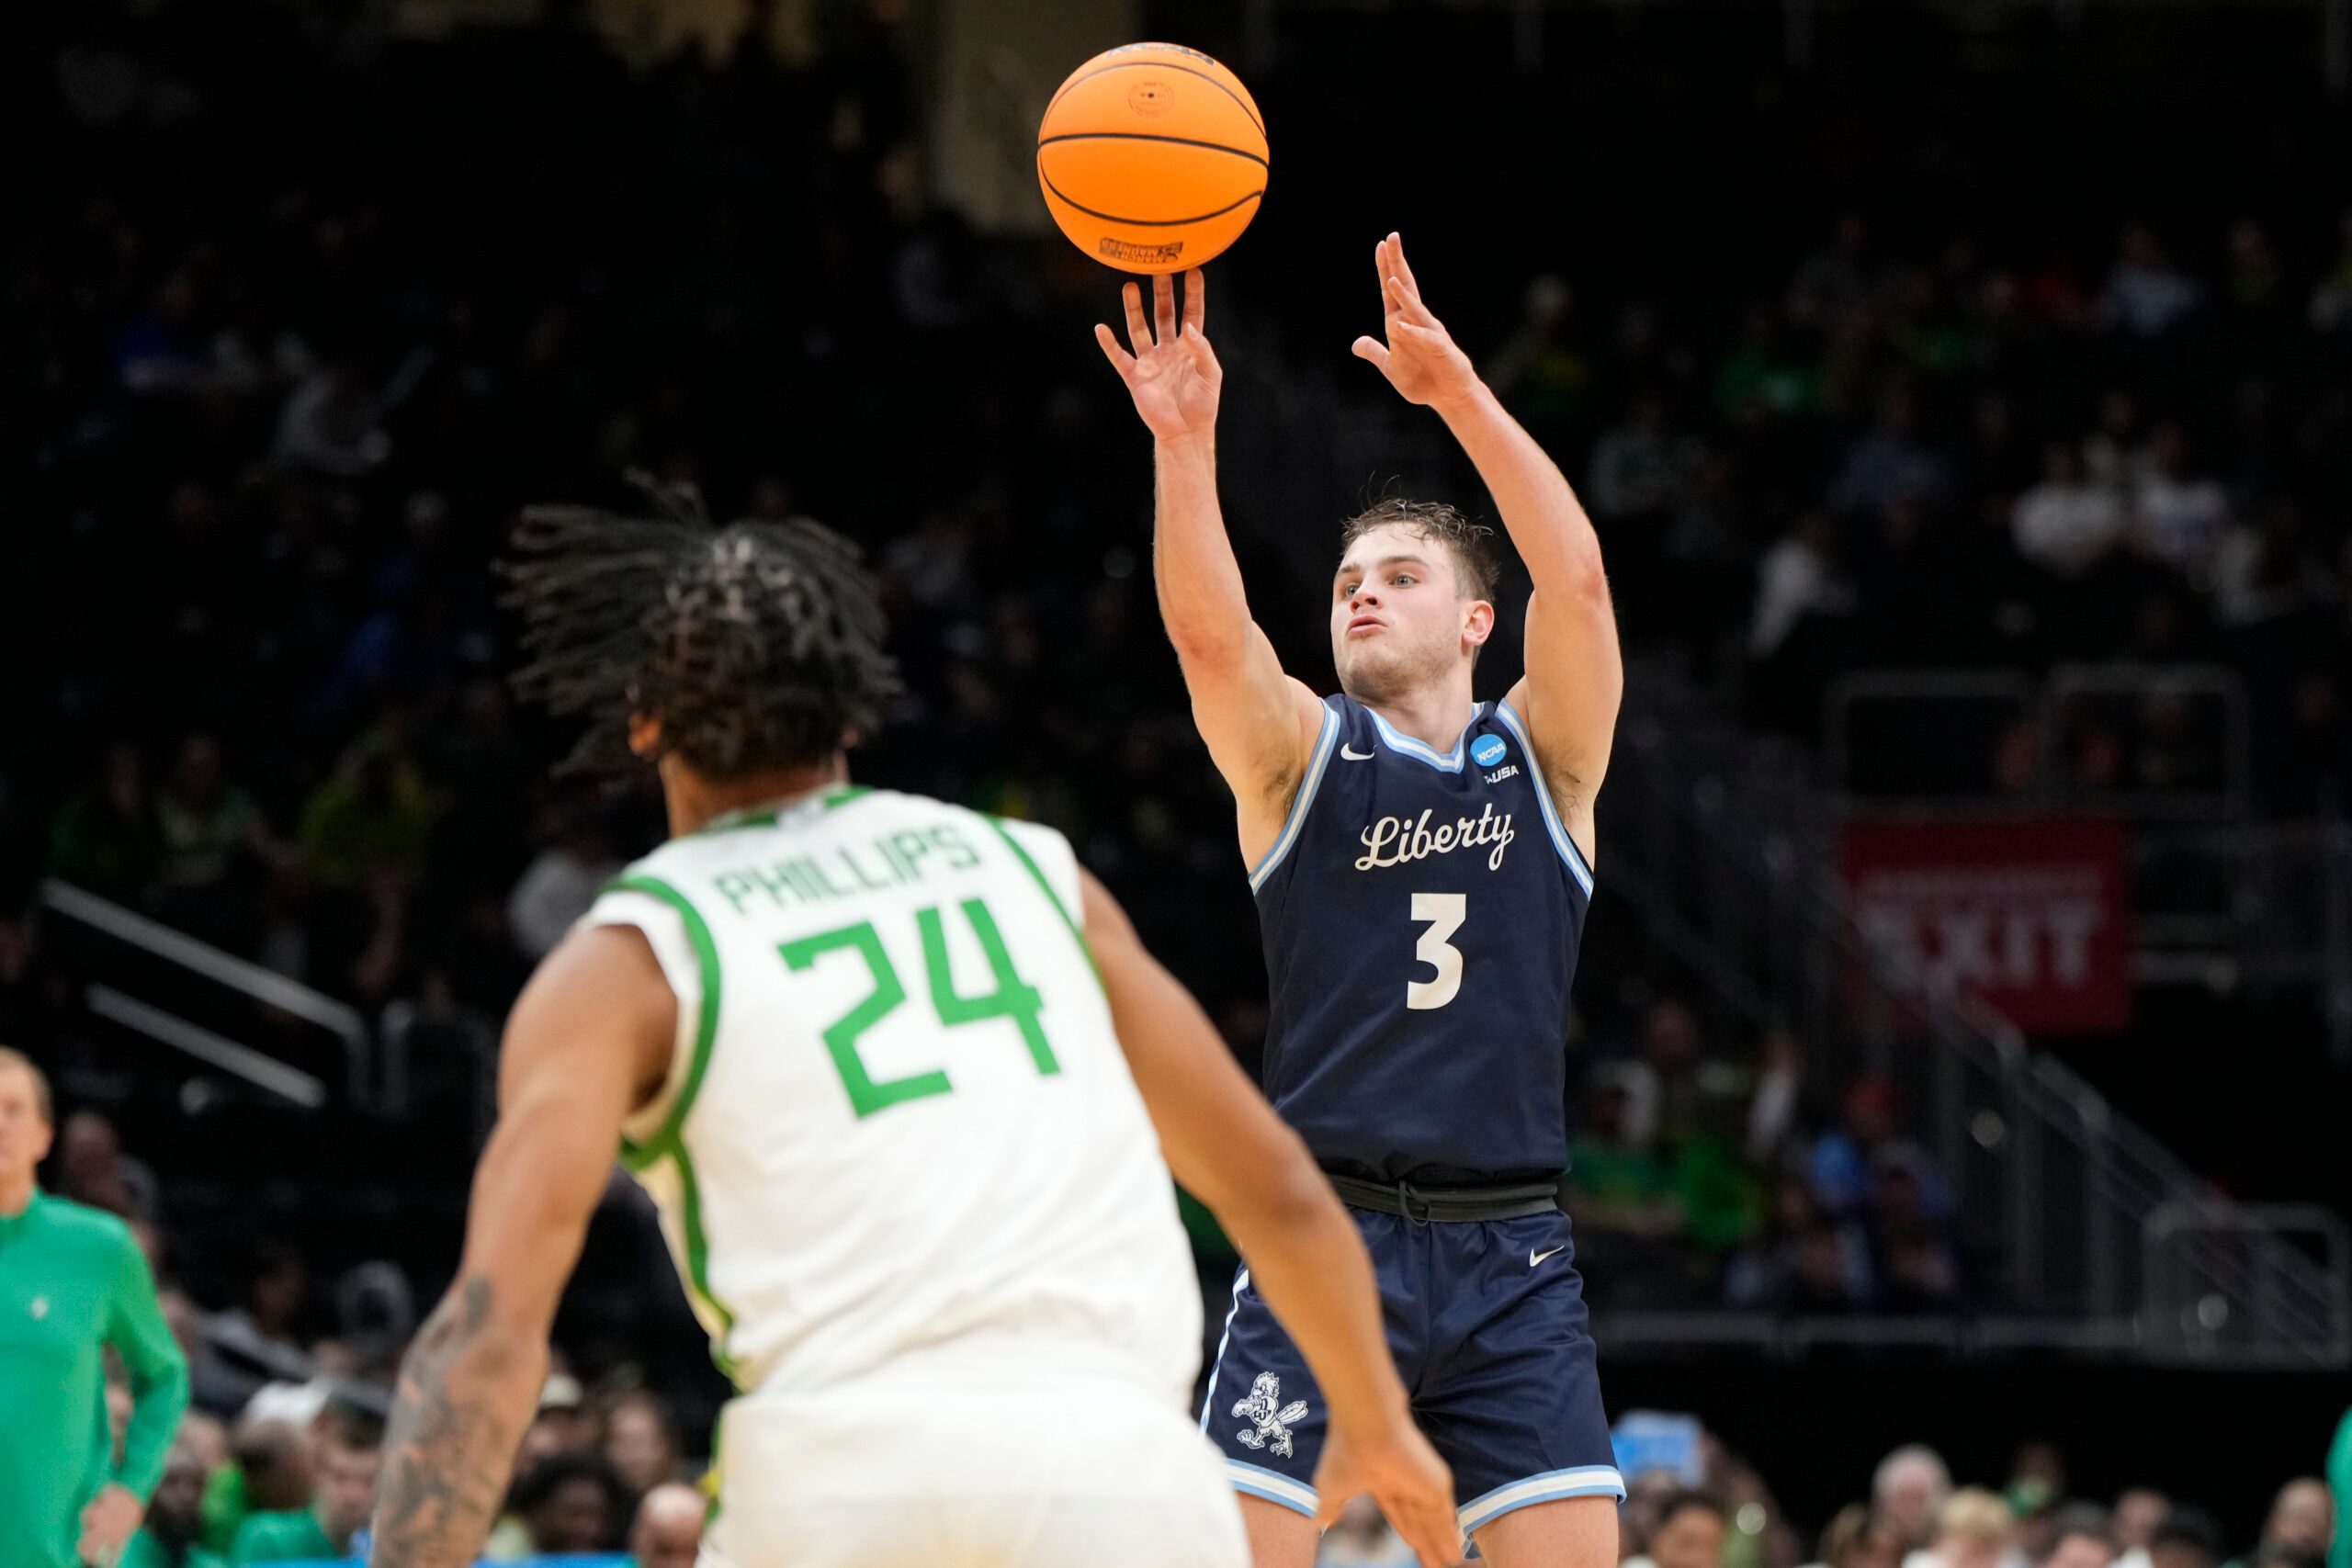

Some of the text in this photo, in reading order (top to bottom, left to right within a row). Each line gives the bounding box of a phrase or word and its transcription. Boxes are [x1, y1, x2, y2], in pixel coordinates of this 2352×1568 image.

[1476, 743, 1505, 762] NCAA
[714, 826, 980, 915] PHILLIPS
[1354, 803, 1514, 871] Liberty
[1407, 893, 1466, 1010] 3
[776, 897, 1062, 1120] 24
